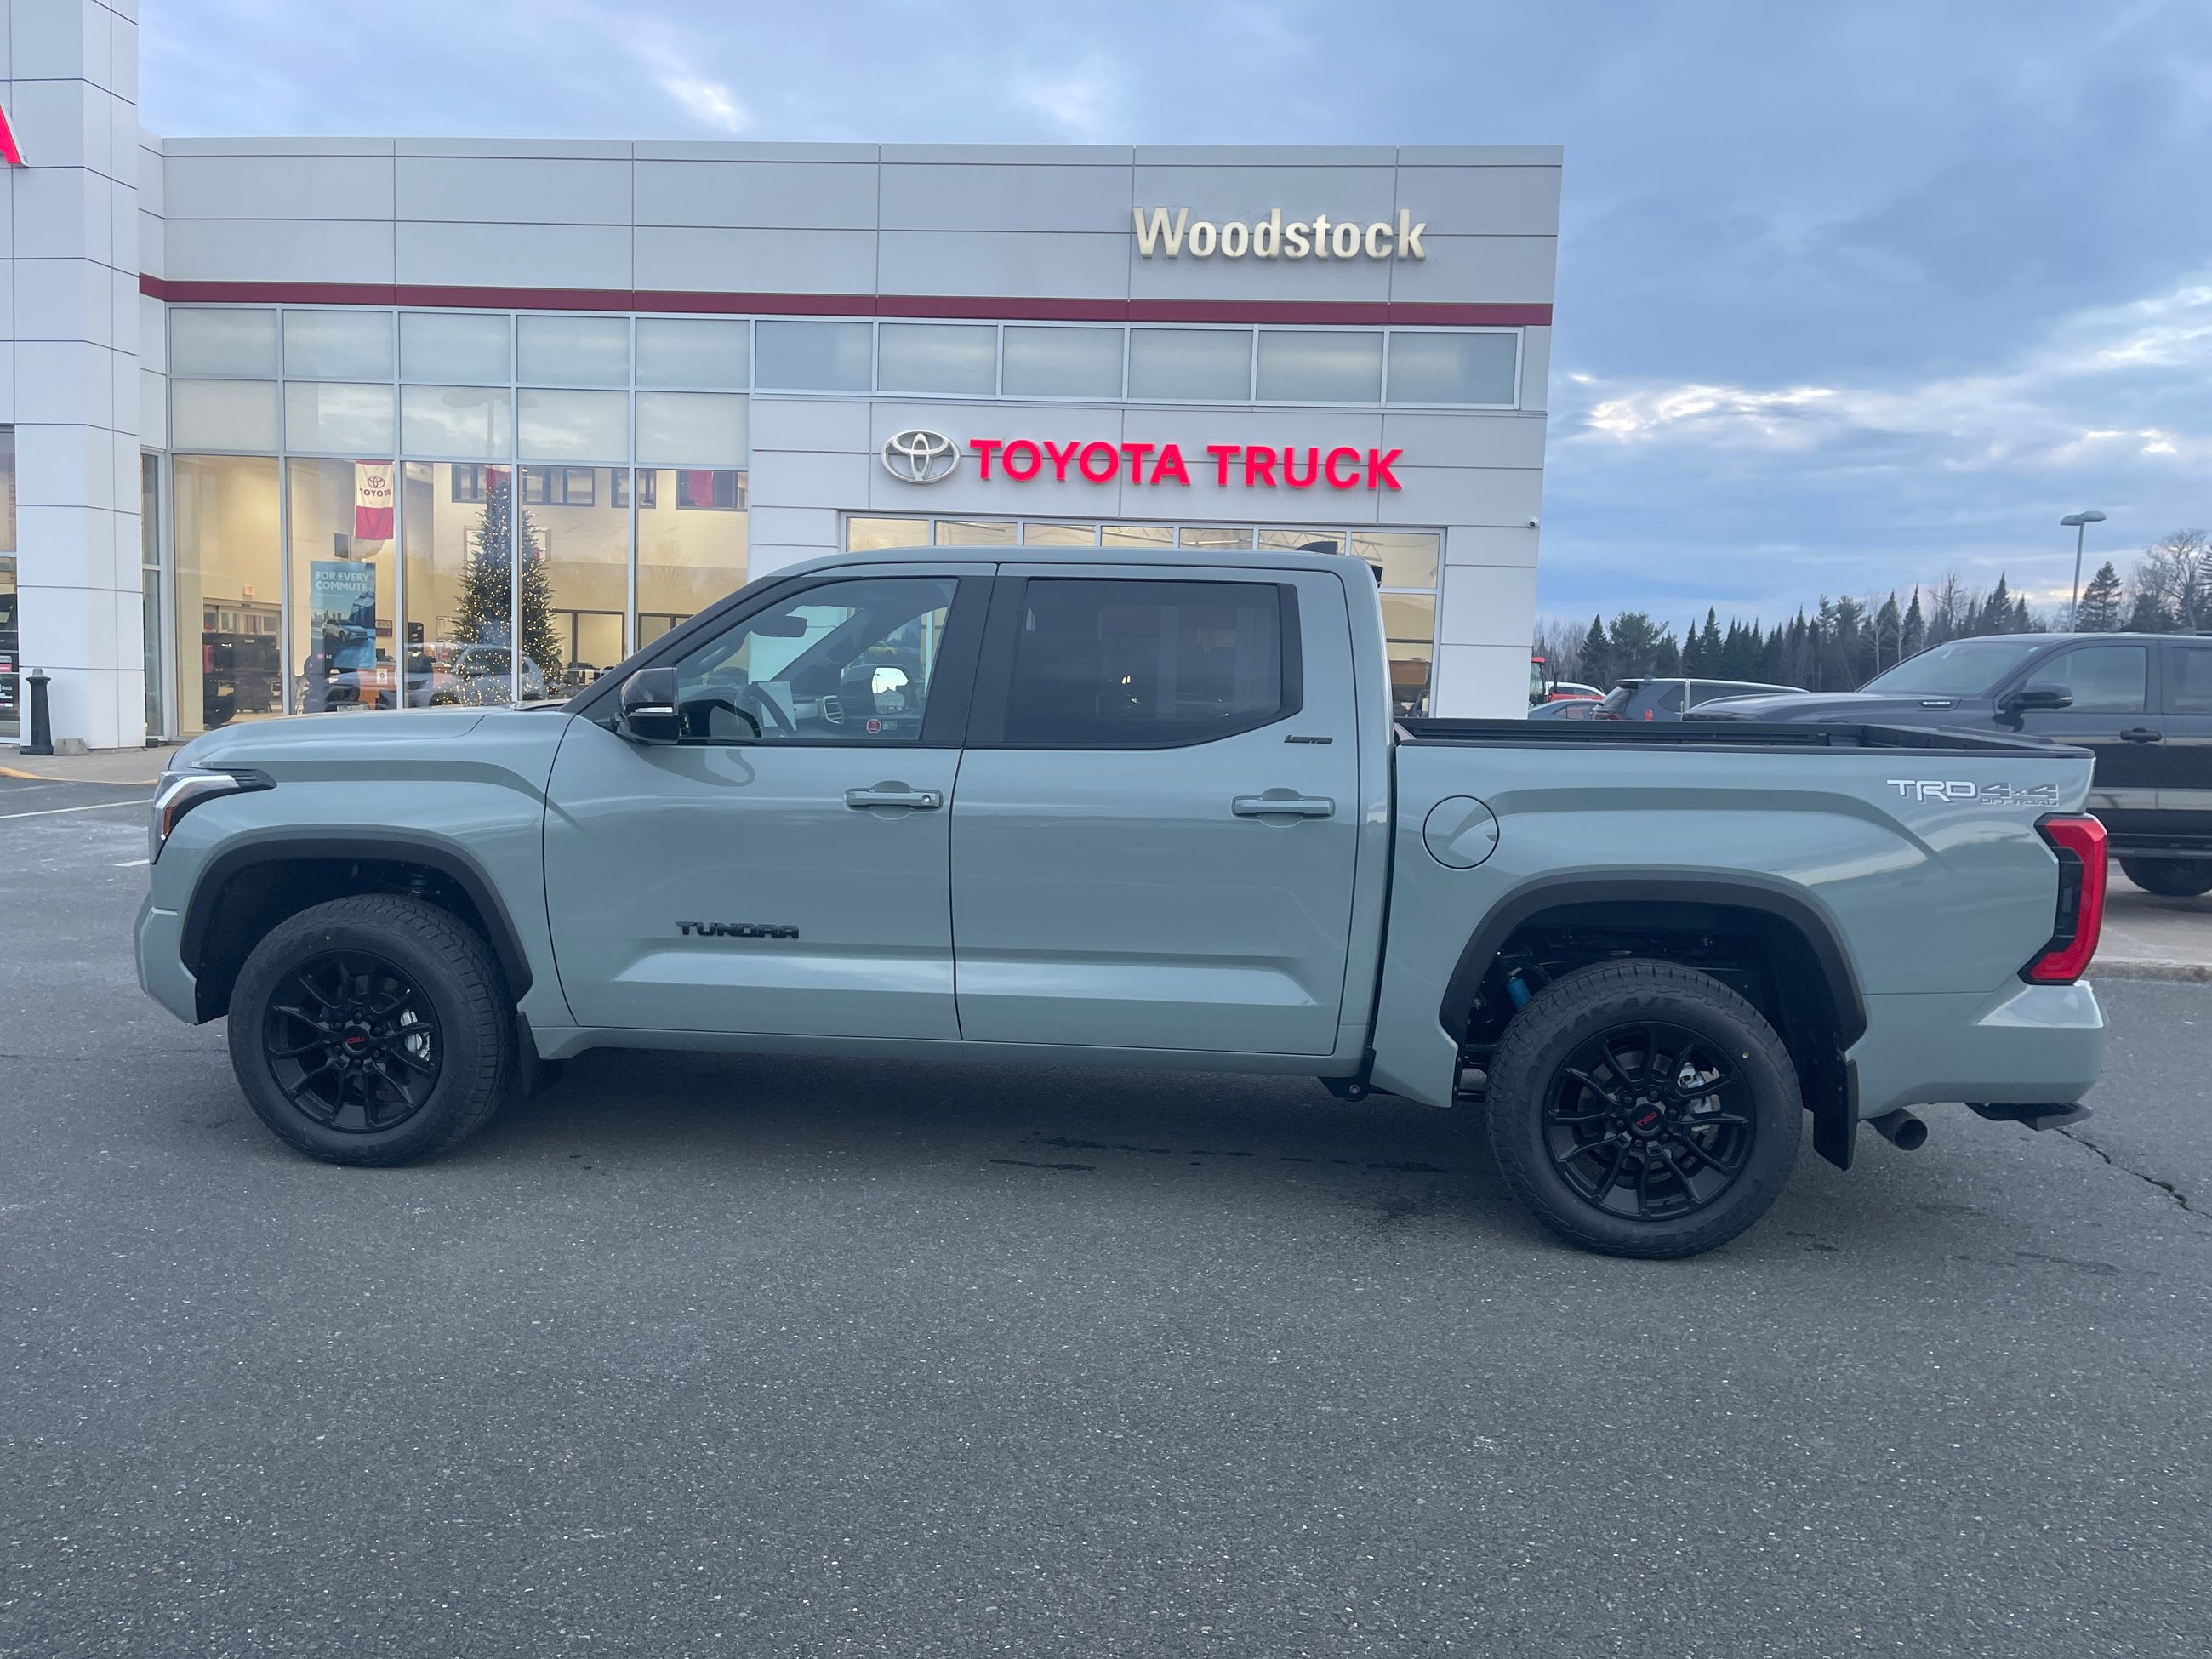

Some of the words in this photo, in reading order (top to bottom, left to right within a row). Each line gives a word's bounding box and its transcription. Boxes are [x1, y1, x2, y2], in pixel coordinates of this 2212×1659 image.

[1132, 206, 1428, 260] Woodstock
[970, 439, 1190, 485] TOYOTA
[1208, 445, 1404, 491] TRUCK
[316, 571, 336, 580] FOR
[338, 572, 369, 582] EVERY
[1886, 779, 1977, 803] TRD
[1979, 782, 2059, 801] 4x4
[676, 921, 799, 939] TUNDRA
